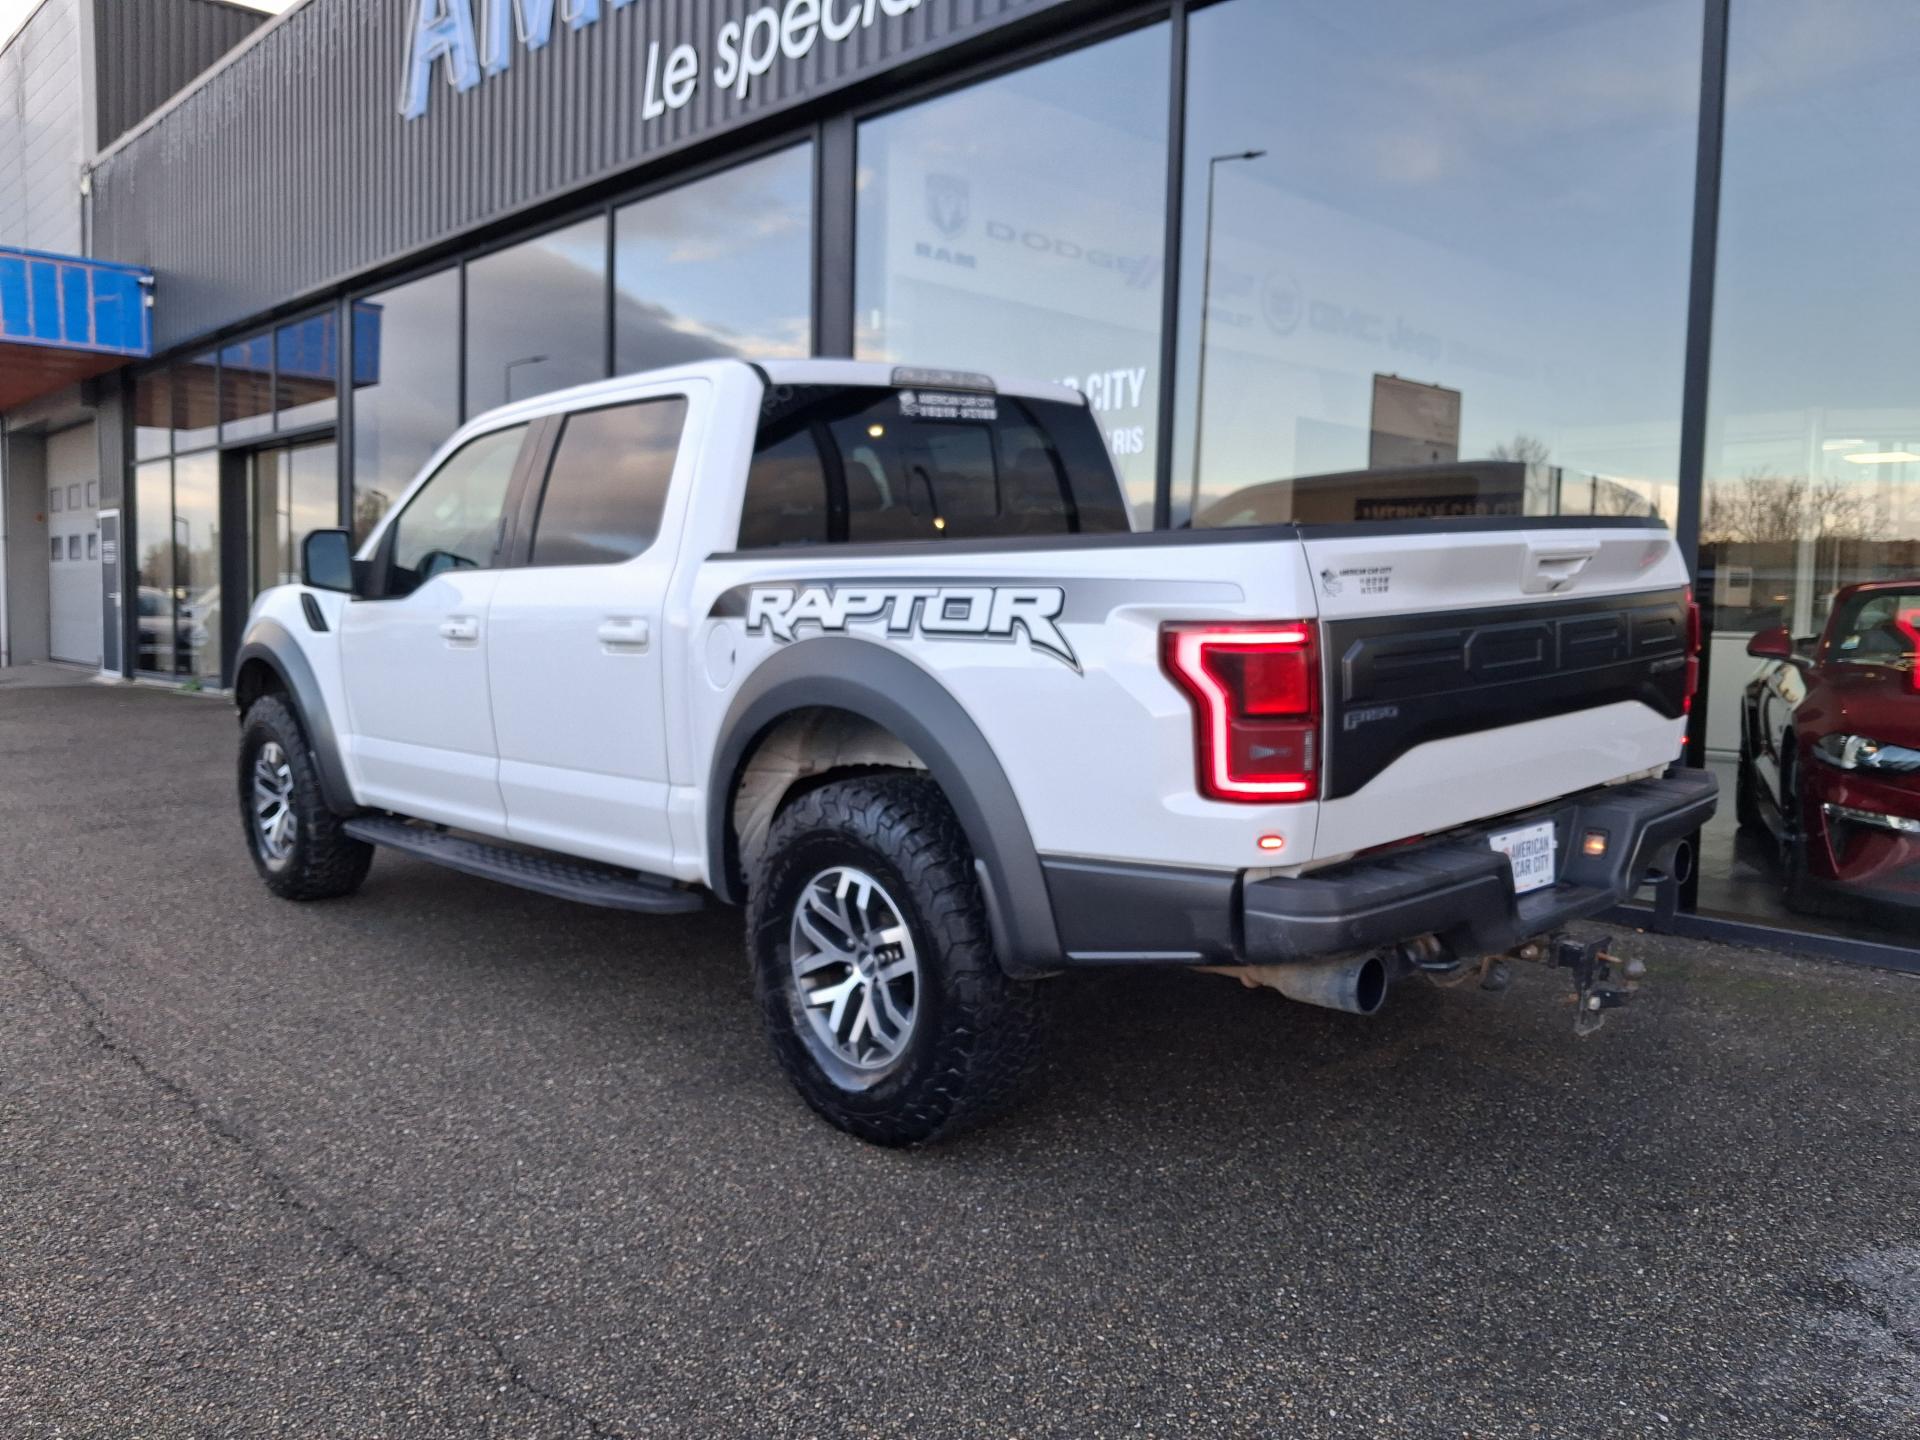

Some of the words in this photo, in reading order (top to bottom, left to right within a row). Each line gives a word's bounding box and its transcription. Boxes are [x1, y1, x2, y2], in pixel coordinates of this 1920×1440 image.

[642, 41, 698, 120] Le
[915, 241, 976, 269] RAM
[986, 221, 1138, 273] DODGE
[1086, 367, 1146, 412] CITY
[1106, 425, 1144, 455] RIS
[746, 585, 1084, 676] RAPTOR
[1343, 603, 1681, 701] FORD
[1512, 836, 1549, 858] AMERICAN
[1514, 858, 1532, 879] CAR
[1534, 853, 1549, 873] CITY
